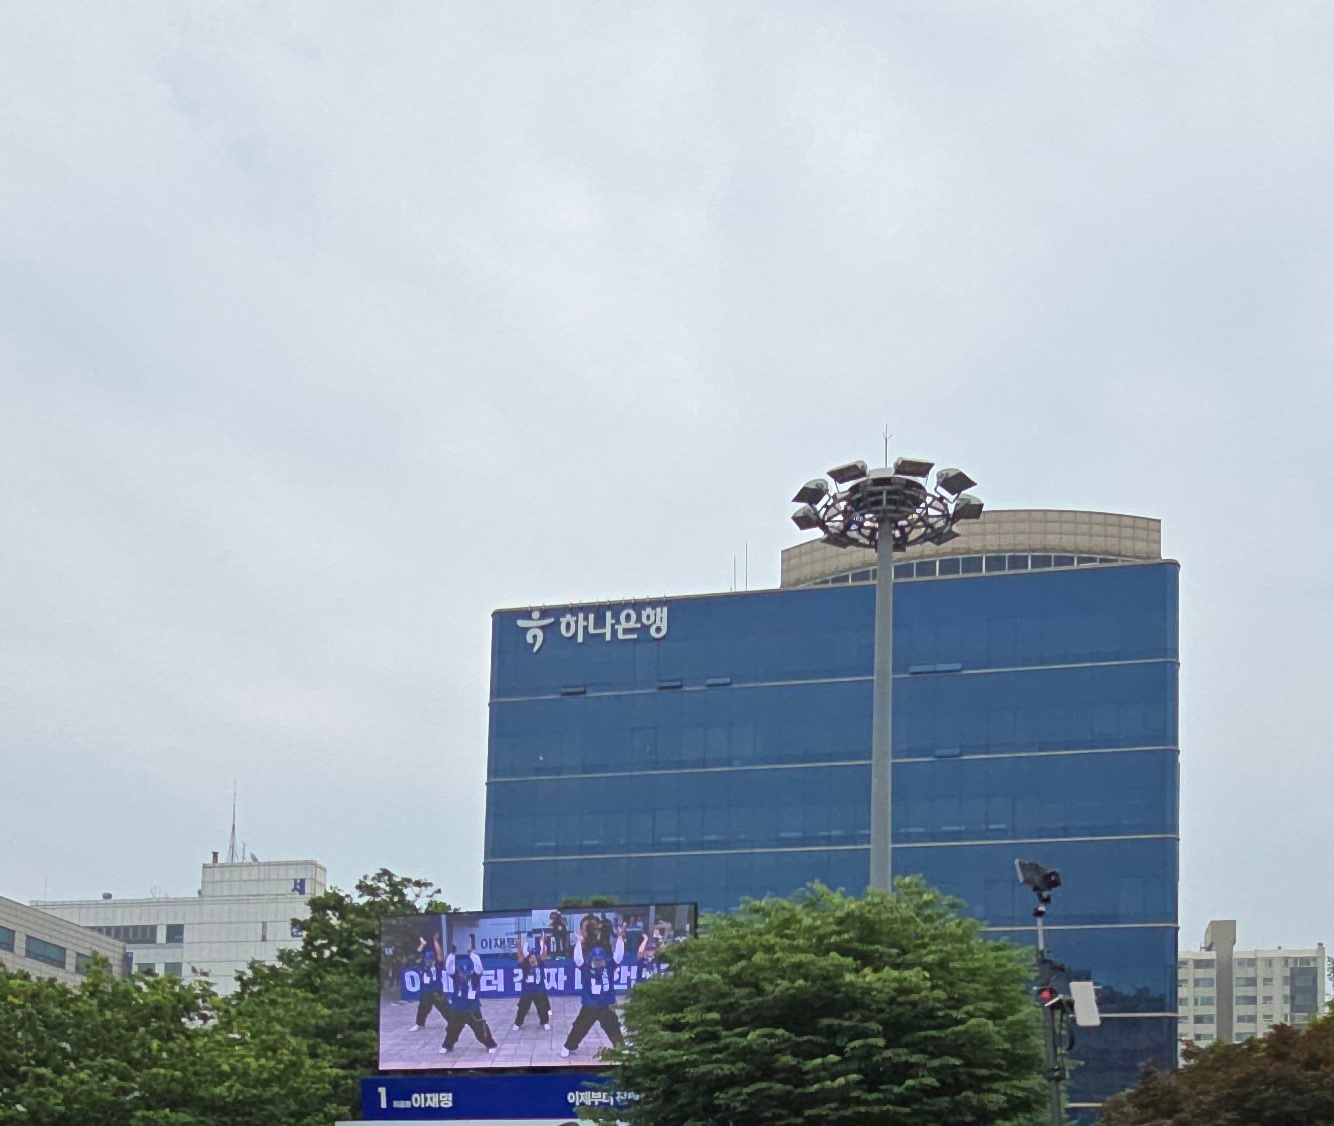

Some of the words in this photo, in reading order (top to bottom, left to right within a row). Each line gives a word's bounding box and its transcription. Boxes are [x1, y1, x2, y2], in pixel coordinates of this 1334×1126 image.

[559, 606, 668, 643] 하나은행
[377, 1087, 388, 1109] 1
[412, 1094, 453, 1108] 이재명
